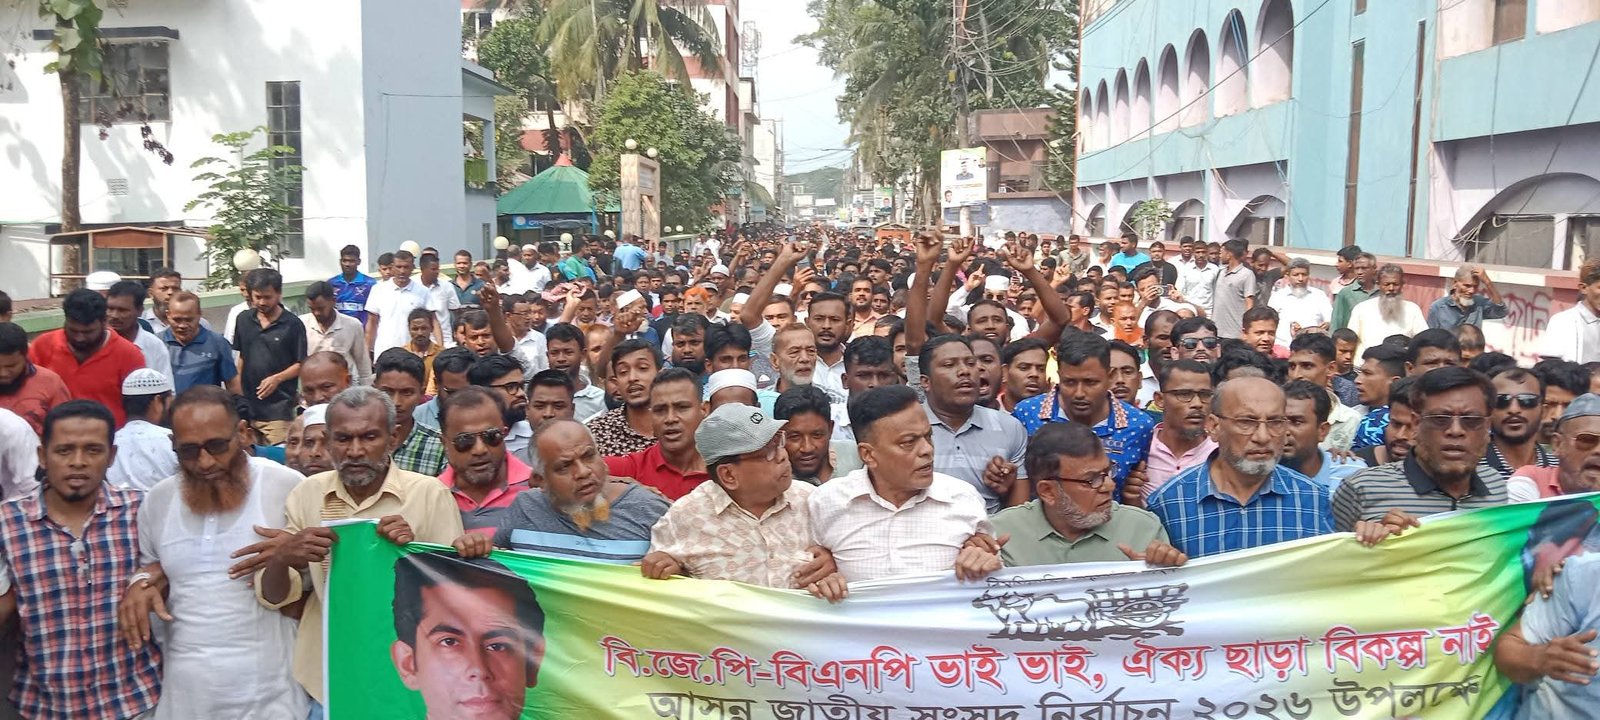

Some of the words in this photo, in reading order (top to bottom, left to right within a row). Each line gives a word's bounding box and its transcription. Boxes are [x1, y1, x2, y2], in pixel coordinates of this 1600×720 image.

[601, 636, 919, 691] বি.জে.পি-বিএনপি
[925, 643, 1006, 692] ভাই
[1013, 643, 1108, 690] ভাই,
[1121, 640, 1213, 682] ঐক্য
[1221, 636, 1312, 681] ছাড়া
[1320, 625, 1432, 673] বিকল্প
[1436, 610, 1498, 664] নাই
[1193, 692, 1313, 720] ২০২৬
